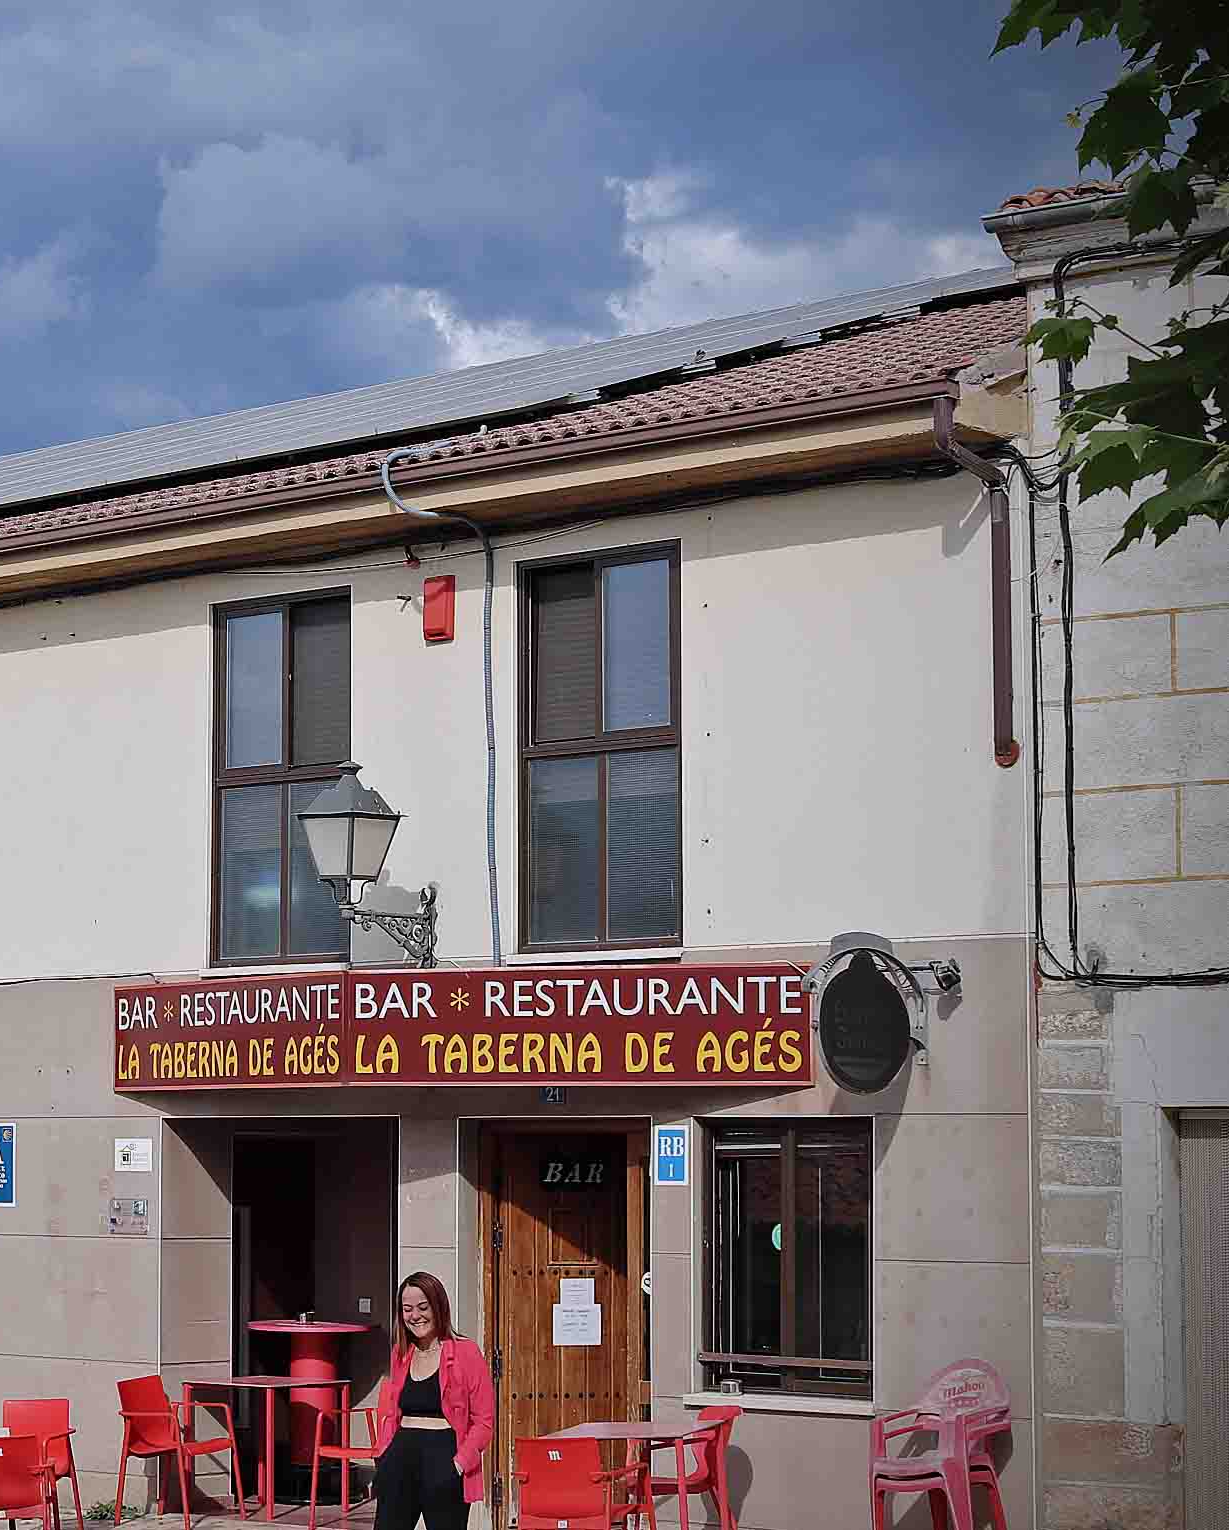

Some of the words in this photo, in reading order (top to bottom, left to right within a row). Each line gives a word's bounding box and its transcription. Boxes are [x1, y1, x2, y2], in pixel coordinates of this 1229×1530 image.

[118, 997, 158, 1031] BAR
[180, 983, 340, 1027] RESTAURANTE
[355, 982, 438, 1019] BAR
[485, 976, 802, 1017] RESTAURANTE
[118, 1043, 140, 1080] LA
[149, 1039, 238, 1079] TABERNA
[249, 1038, 275, 1076] DE
[284, 1023, 340, 1075] AGÉS
[355, 1034, 400, 1074] LA
[421, 1032, 602, 1074] TABERNA
[626, 1032, 675, 1073] DE
[696, 1018, 803, 1073] AGÉS
[659, 1136, 684, 1157] RB
[542, 1163, 604, 1183] BAR
